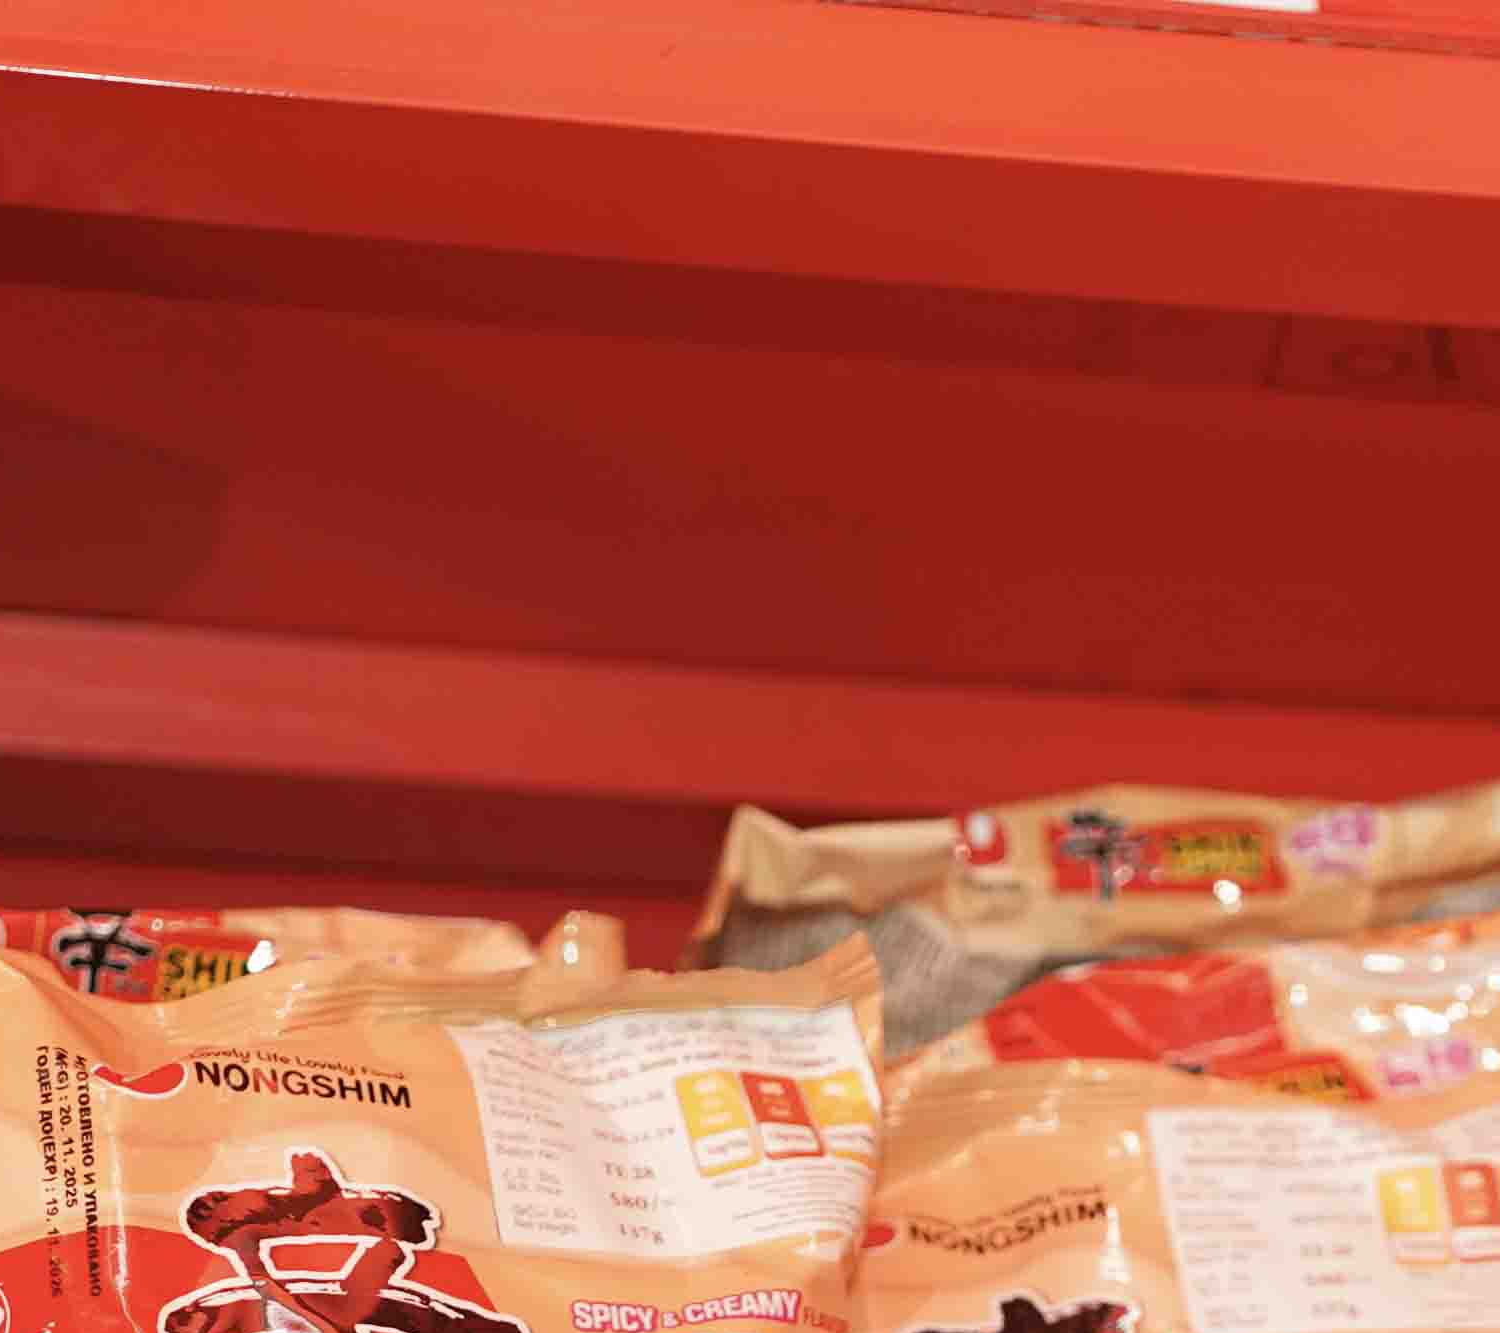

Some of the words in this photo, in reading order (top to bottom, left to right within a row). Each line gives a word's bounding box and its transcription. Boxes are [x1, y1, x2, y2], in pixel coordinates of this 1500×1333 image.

[193, 1060, 413, 1110] NONGSHIM
[572, 1300, 657, 1333] SPICY
[684, 1289, 801, 1324] CREAMY
